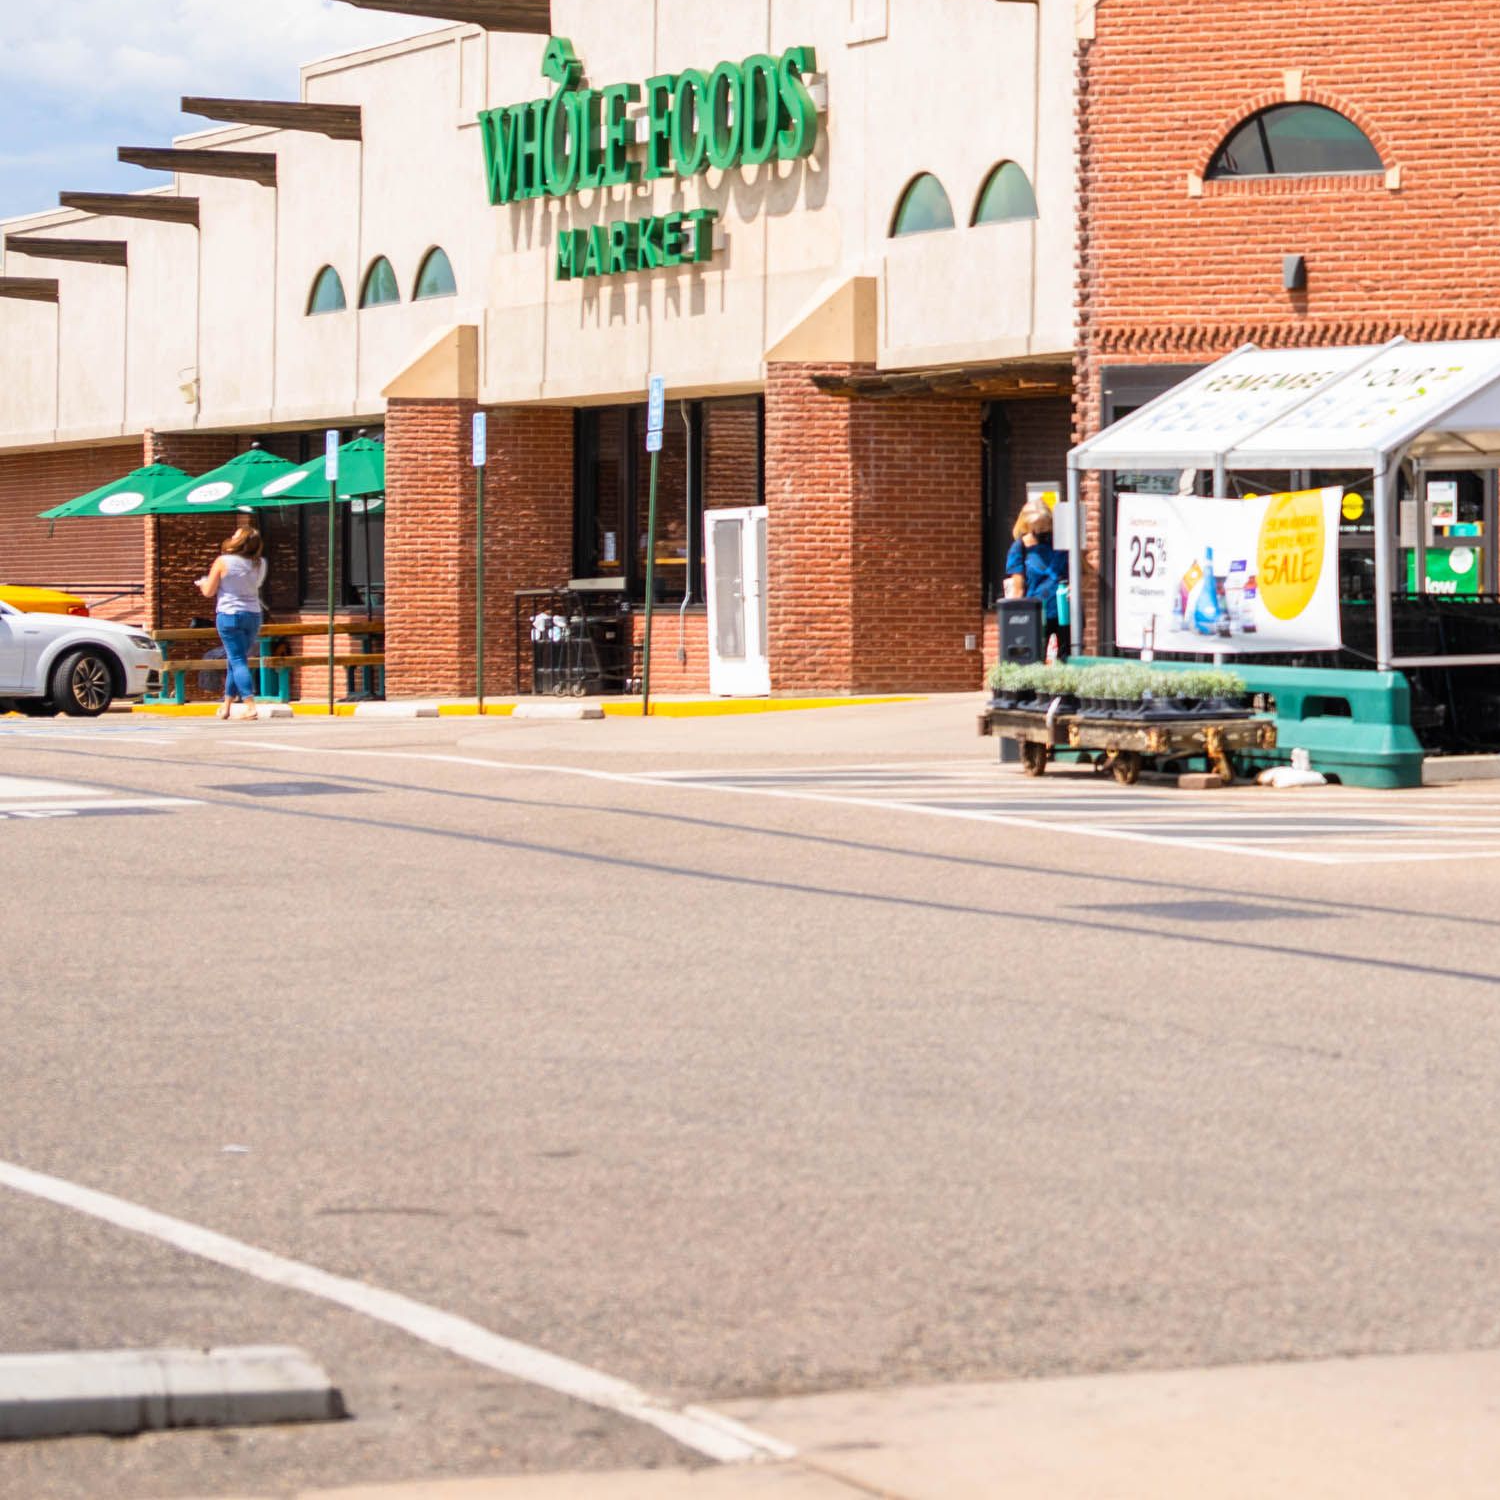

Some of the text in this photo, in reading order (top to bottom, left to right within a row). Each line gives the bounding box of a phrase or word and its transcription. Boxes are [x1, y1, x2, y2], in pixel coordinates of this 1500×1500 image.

[477, 36, 819, 206] WHOLE FOODS
[554, 207, 719, 281] MARKET
[1203, 370, 1338, 393] REMEMBE
[1263, 549, 1314, 586] SALE
